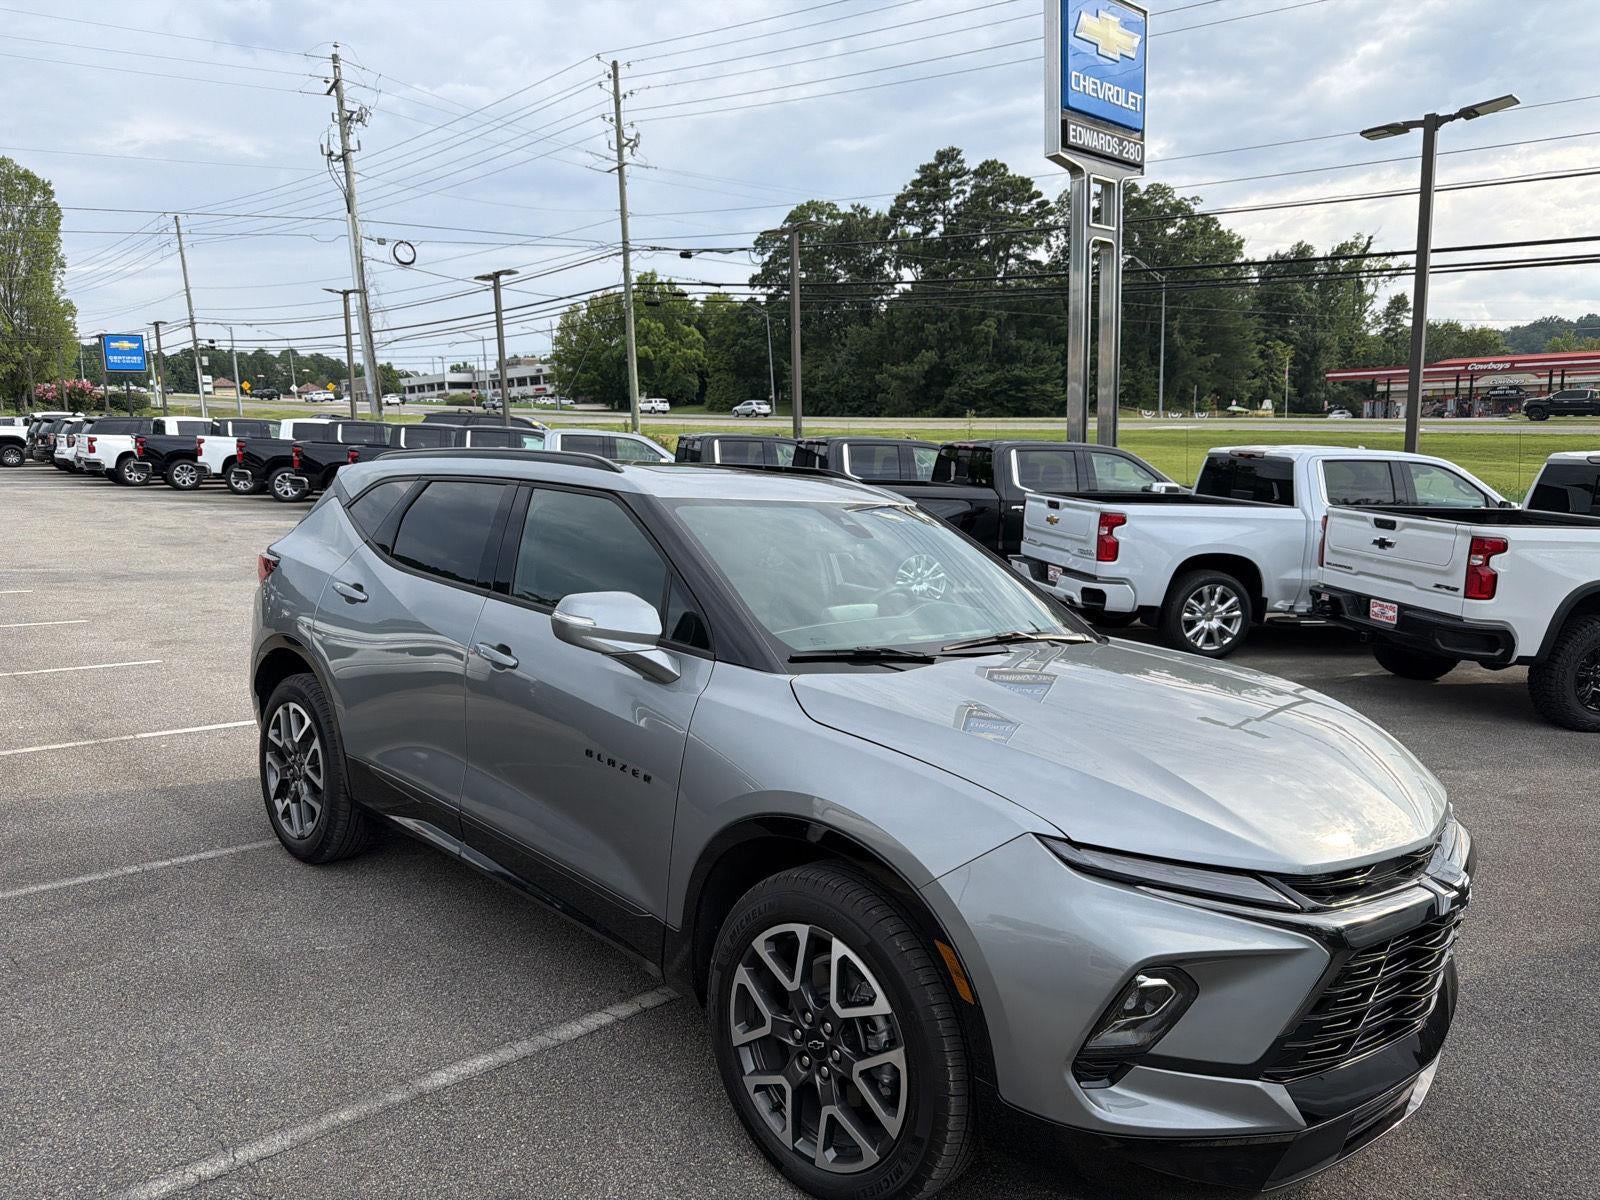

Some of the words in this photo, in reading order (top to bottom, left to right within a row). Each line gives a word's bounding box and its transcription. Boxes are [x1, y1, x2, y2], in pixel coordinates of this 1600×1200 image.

[1071, 70, 1142, 112] CHEVROLET
[1468, 362, 1511, 371] Cowboys
[585, 748, 652, 785] BLAZER
